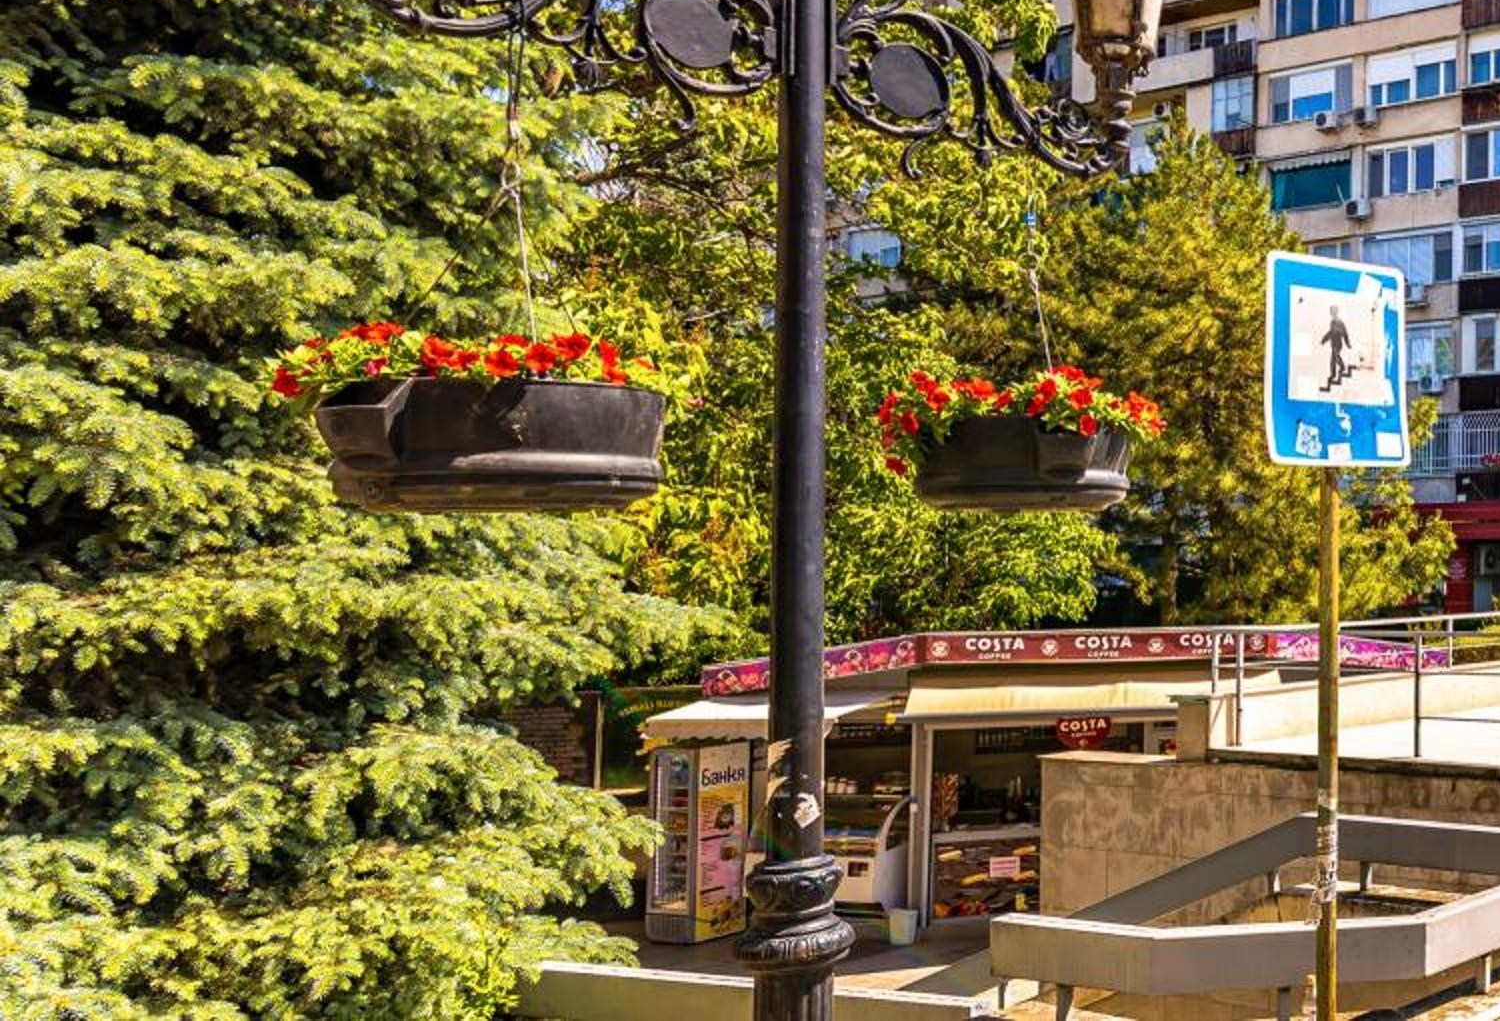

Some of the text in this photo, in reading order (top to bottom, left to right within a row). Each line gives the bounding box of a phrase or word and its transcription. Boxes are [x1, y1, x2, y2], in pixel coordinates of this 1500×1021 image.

[965, 637, 1025, 652] COSTA
[1075, 635, 1133, 650] COSTA
[1087, 650, 1119, 658] COFFEE
[1060, 718, 1107, 732] COSTA
[701, 765, 745, 788] Банкя
